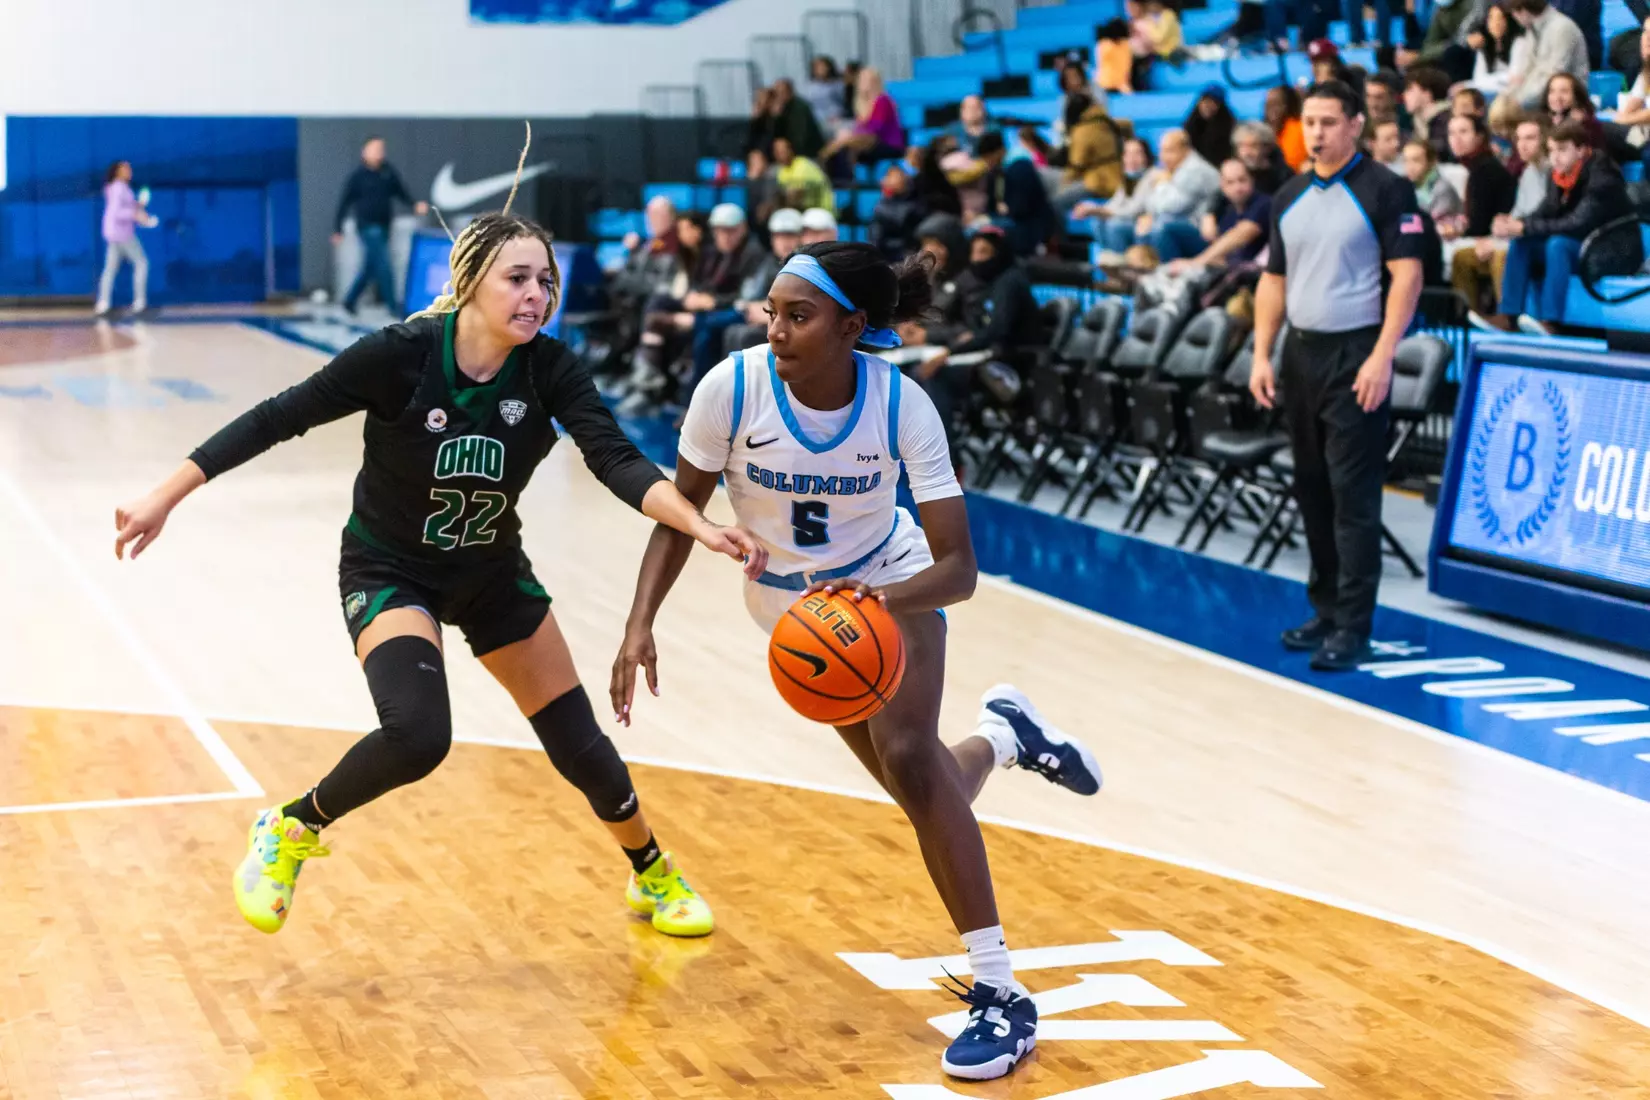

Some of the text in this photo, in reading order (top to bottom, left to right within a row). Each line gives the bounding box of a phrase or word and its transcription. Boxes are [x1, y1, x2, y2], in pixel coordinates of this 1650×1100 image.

[434, 435, 505, 481] OHIO
[746, 462, 882, 495] COLUMBIA
[856, 453, 873, 464] Ivy
[1504, 422, 1537, 492] B
[422, 488, 507, 550] 22
[791, 500, 831, 547] 5
[801, 596, 861, 649] ELITE
